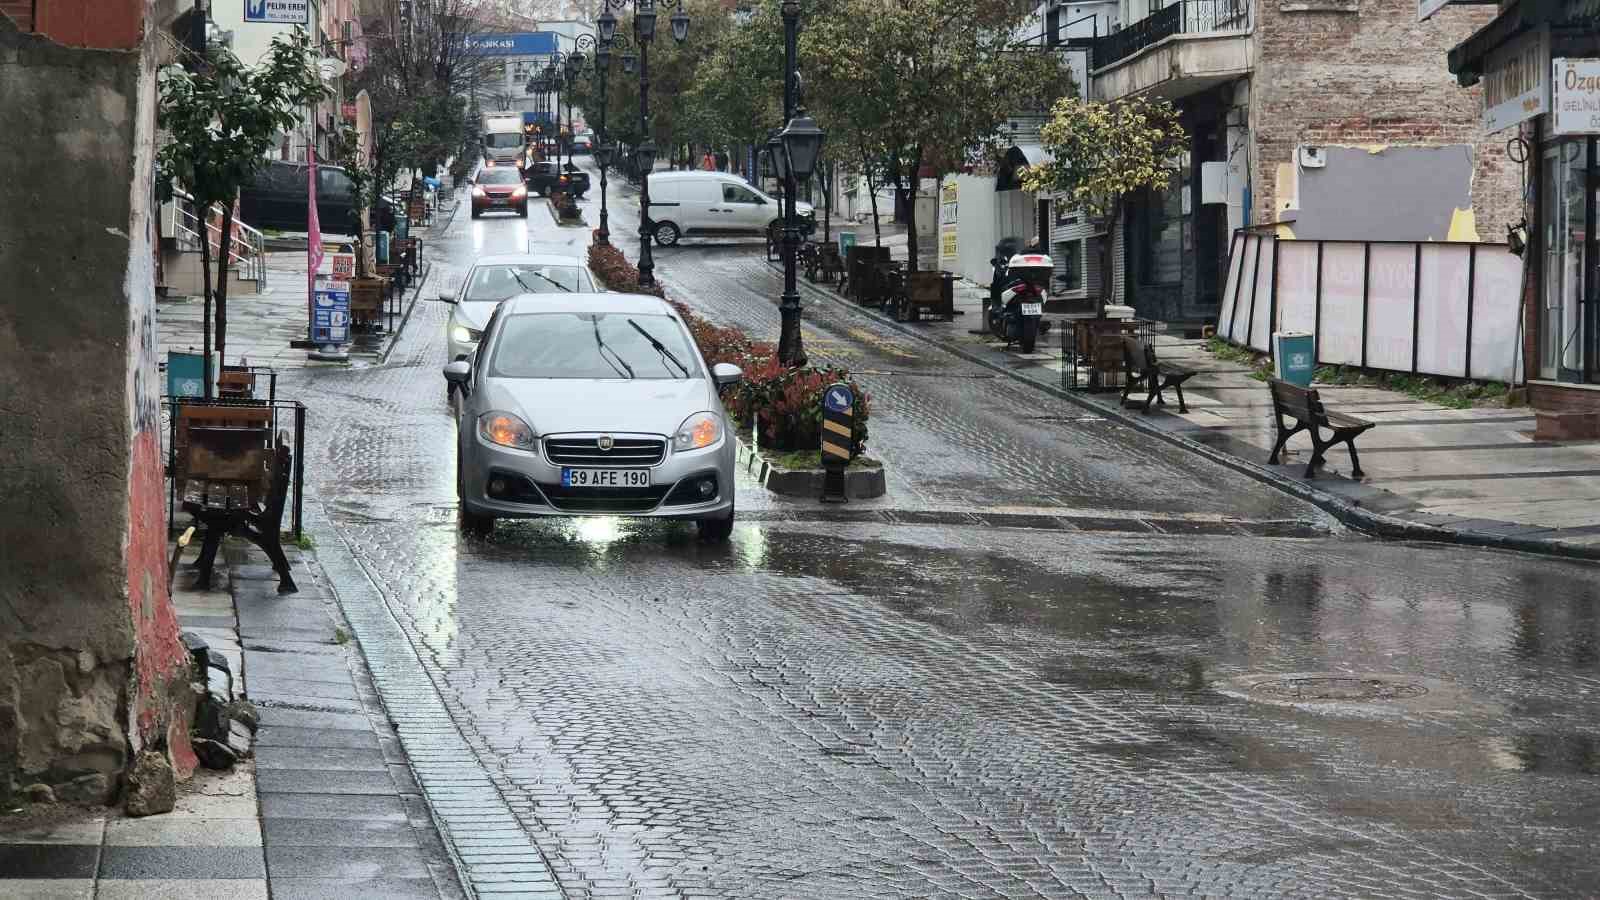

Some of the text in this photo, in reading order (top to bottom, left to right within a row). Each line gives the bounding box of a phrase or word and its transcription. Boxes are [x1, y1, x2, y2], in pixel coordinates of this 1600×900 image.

[571, 471, 648, 485] 59 AFE 190
